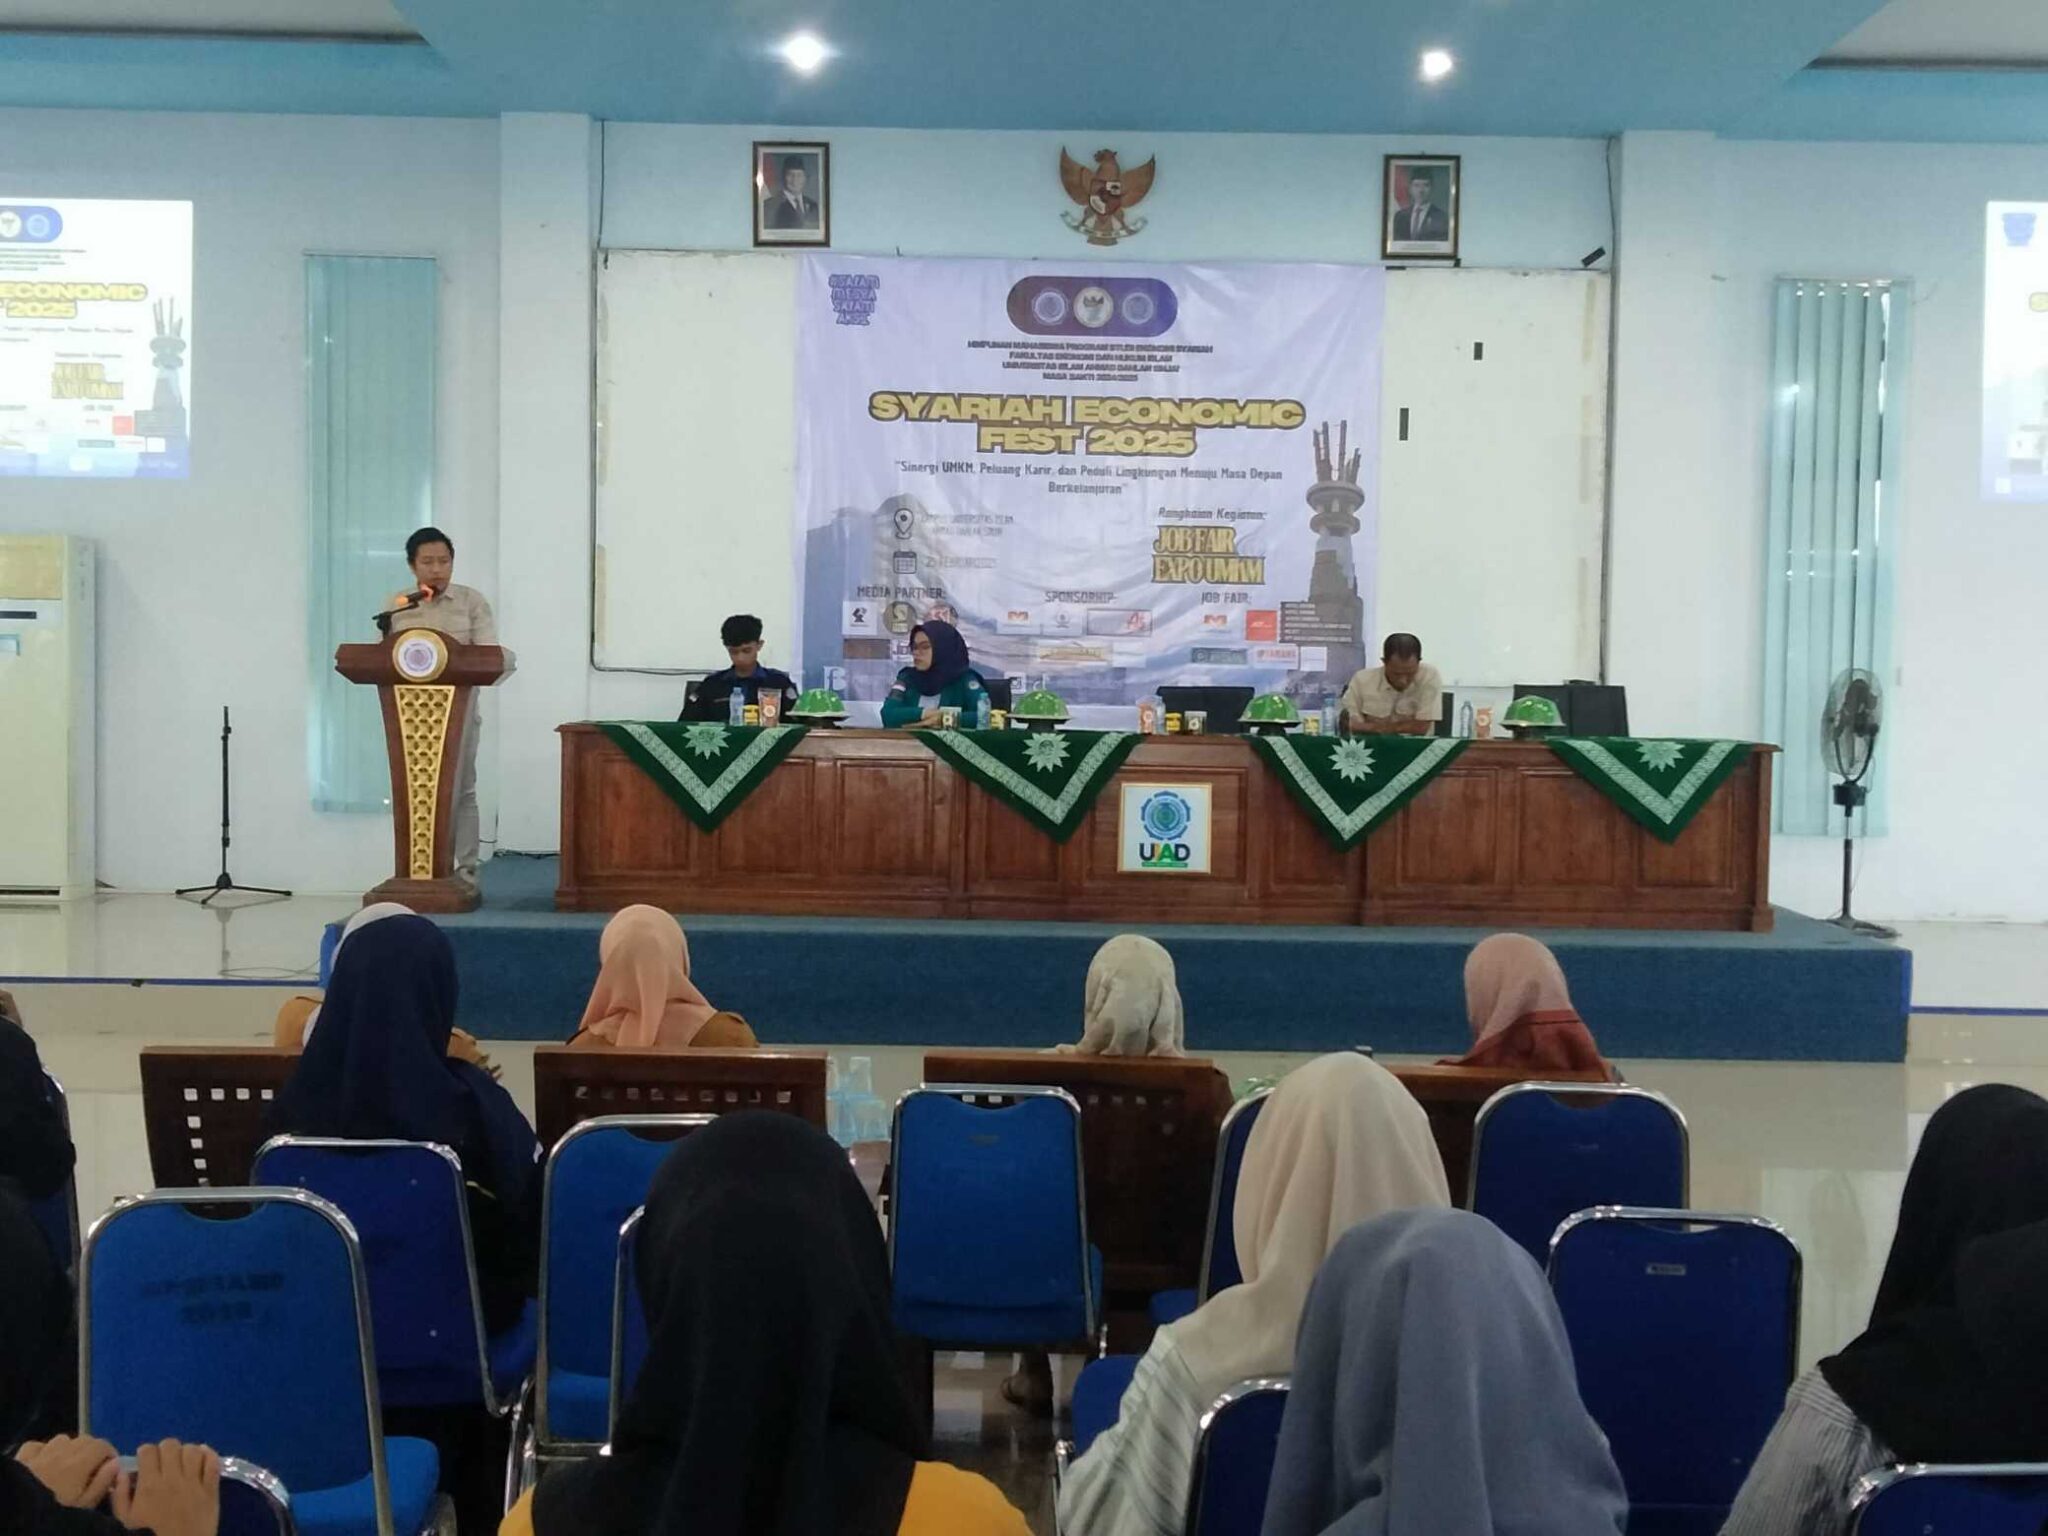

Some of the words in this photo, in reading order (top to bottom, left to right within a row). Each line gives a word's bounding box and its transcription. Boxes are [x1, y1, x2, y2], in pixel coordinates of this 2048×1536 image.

[868, 391, 1066, 422] SYARIAH
[1072, 396, 1306, 429] ECONOMIC
[977, 422, 1083, 454] FEST
[1086, 426, 1197, 457] 2025
[980, 463, 1021, 477] Peluang
[1058, 465, 1077, 476] dan
[1080, 466, 1112, 477] Peduli
[1115, 466, 1177, 480] Lingkungan
[1180, 467, 1217, 480] Menuju
[1221, 468, 1247, 479] Masa
[1250, 468, 1283, 482] Depan
[1153, 525, 1192, 554] JOB
[1192, 526, 1237, 555] FAIR
[1151, 554, 1203, 585] EXPO
[1203, 556, 1265, 585] UMKM
[857, 586, 891, 598] MEDIA
[1201, 592, 1220, 605] JOB
[1139, 842, 1191, 862] UAD
